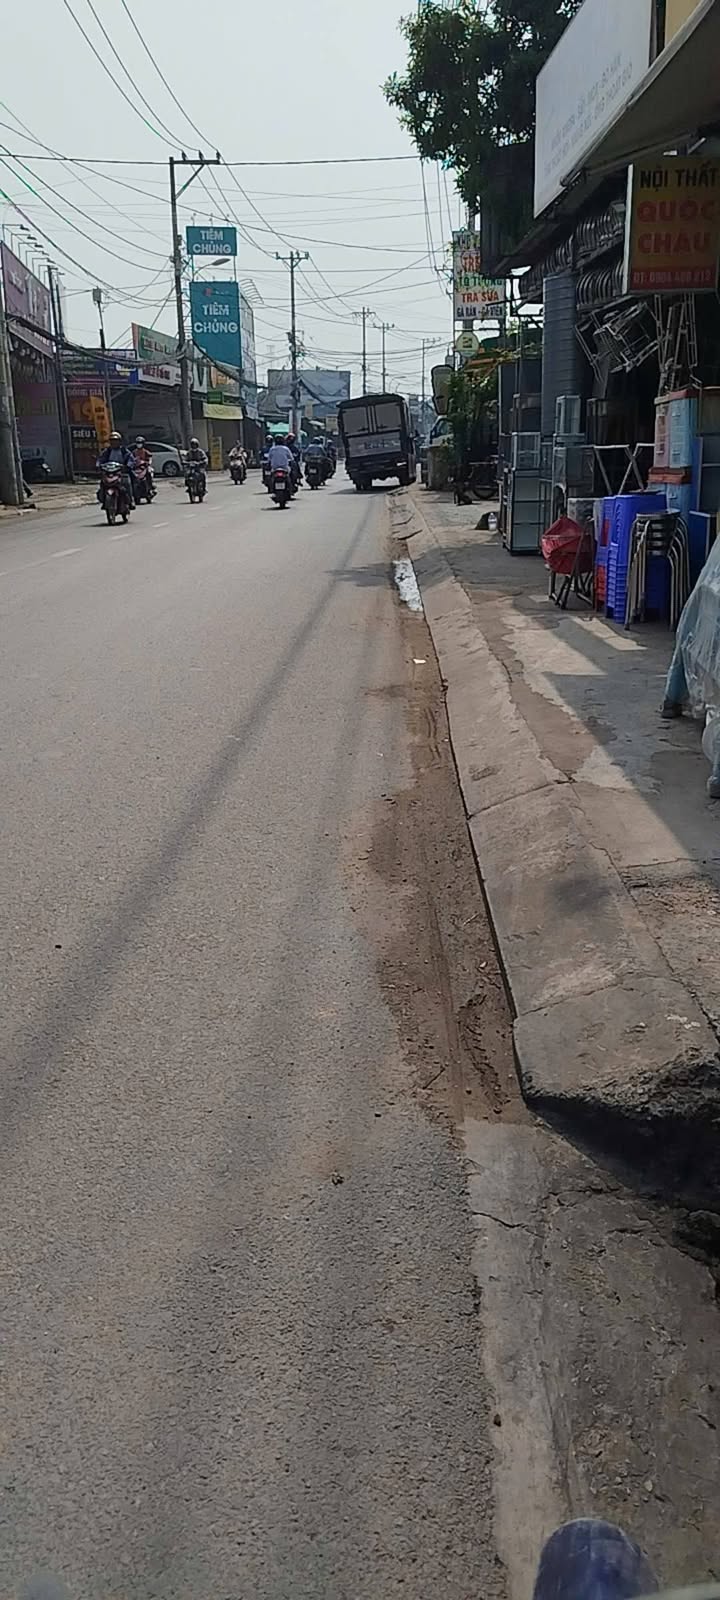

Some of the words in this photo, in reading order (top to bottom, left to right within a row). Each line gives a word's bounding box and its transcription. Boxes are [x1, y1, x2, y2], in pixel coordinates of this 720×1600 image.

[640, 166, 668, 192] NỘI
[676, 161, 719, 188] THẤT
[192, 241, 232, 254] CHỦNG
[202, 302, 229, 316] TIÊM
[193, 320, 238, 334] CHỦNG
